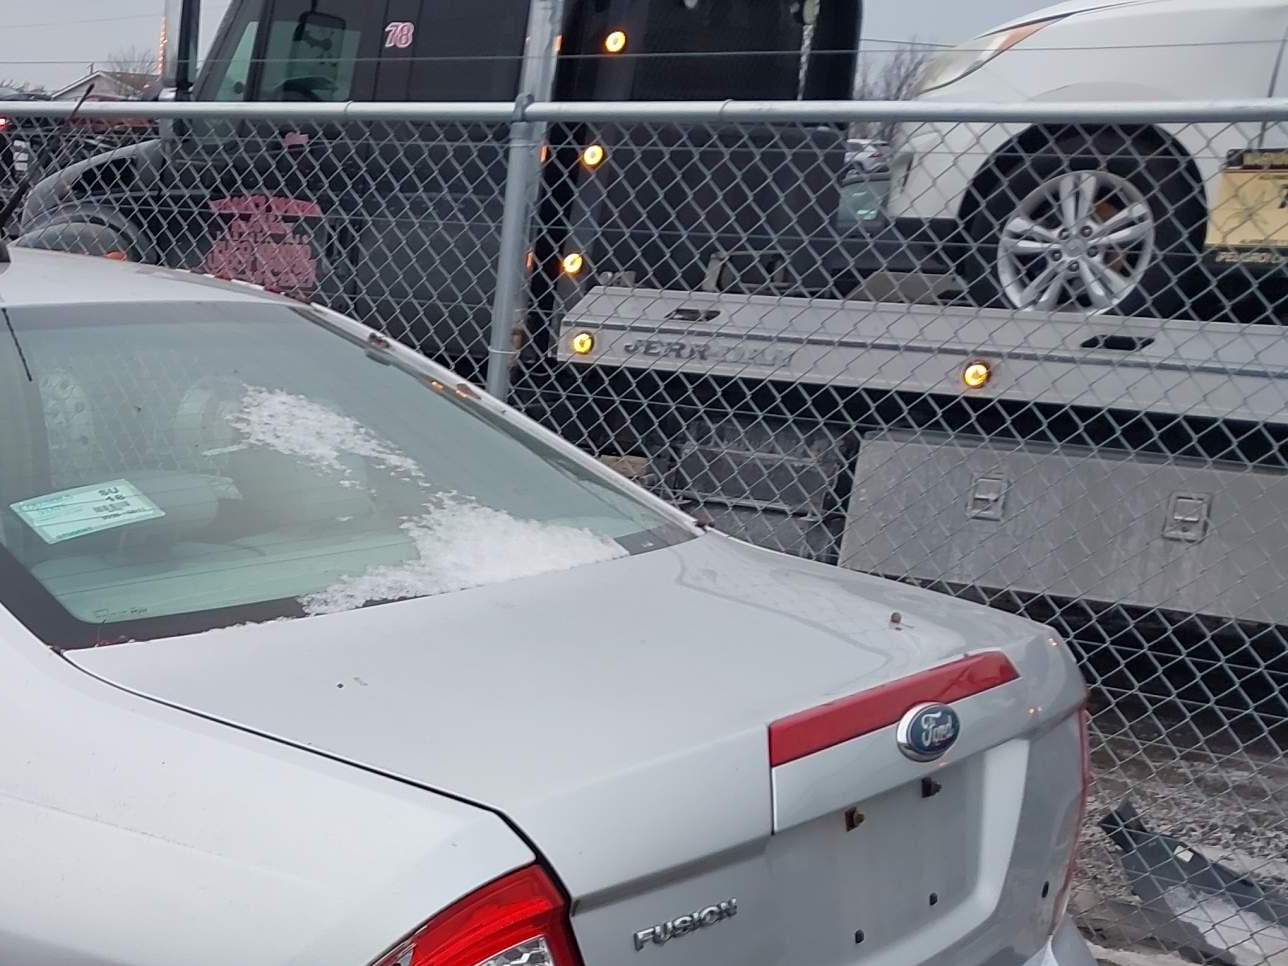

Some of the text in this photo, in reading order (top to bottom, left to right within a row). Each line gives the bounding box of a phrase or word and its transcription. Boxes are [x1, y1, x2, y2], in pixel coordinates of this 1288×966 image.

[385, 21, 415, 48] 78
[921, 711, 953, 746] Ford
[633, 897, 738, 952] FUSION
